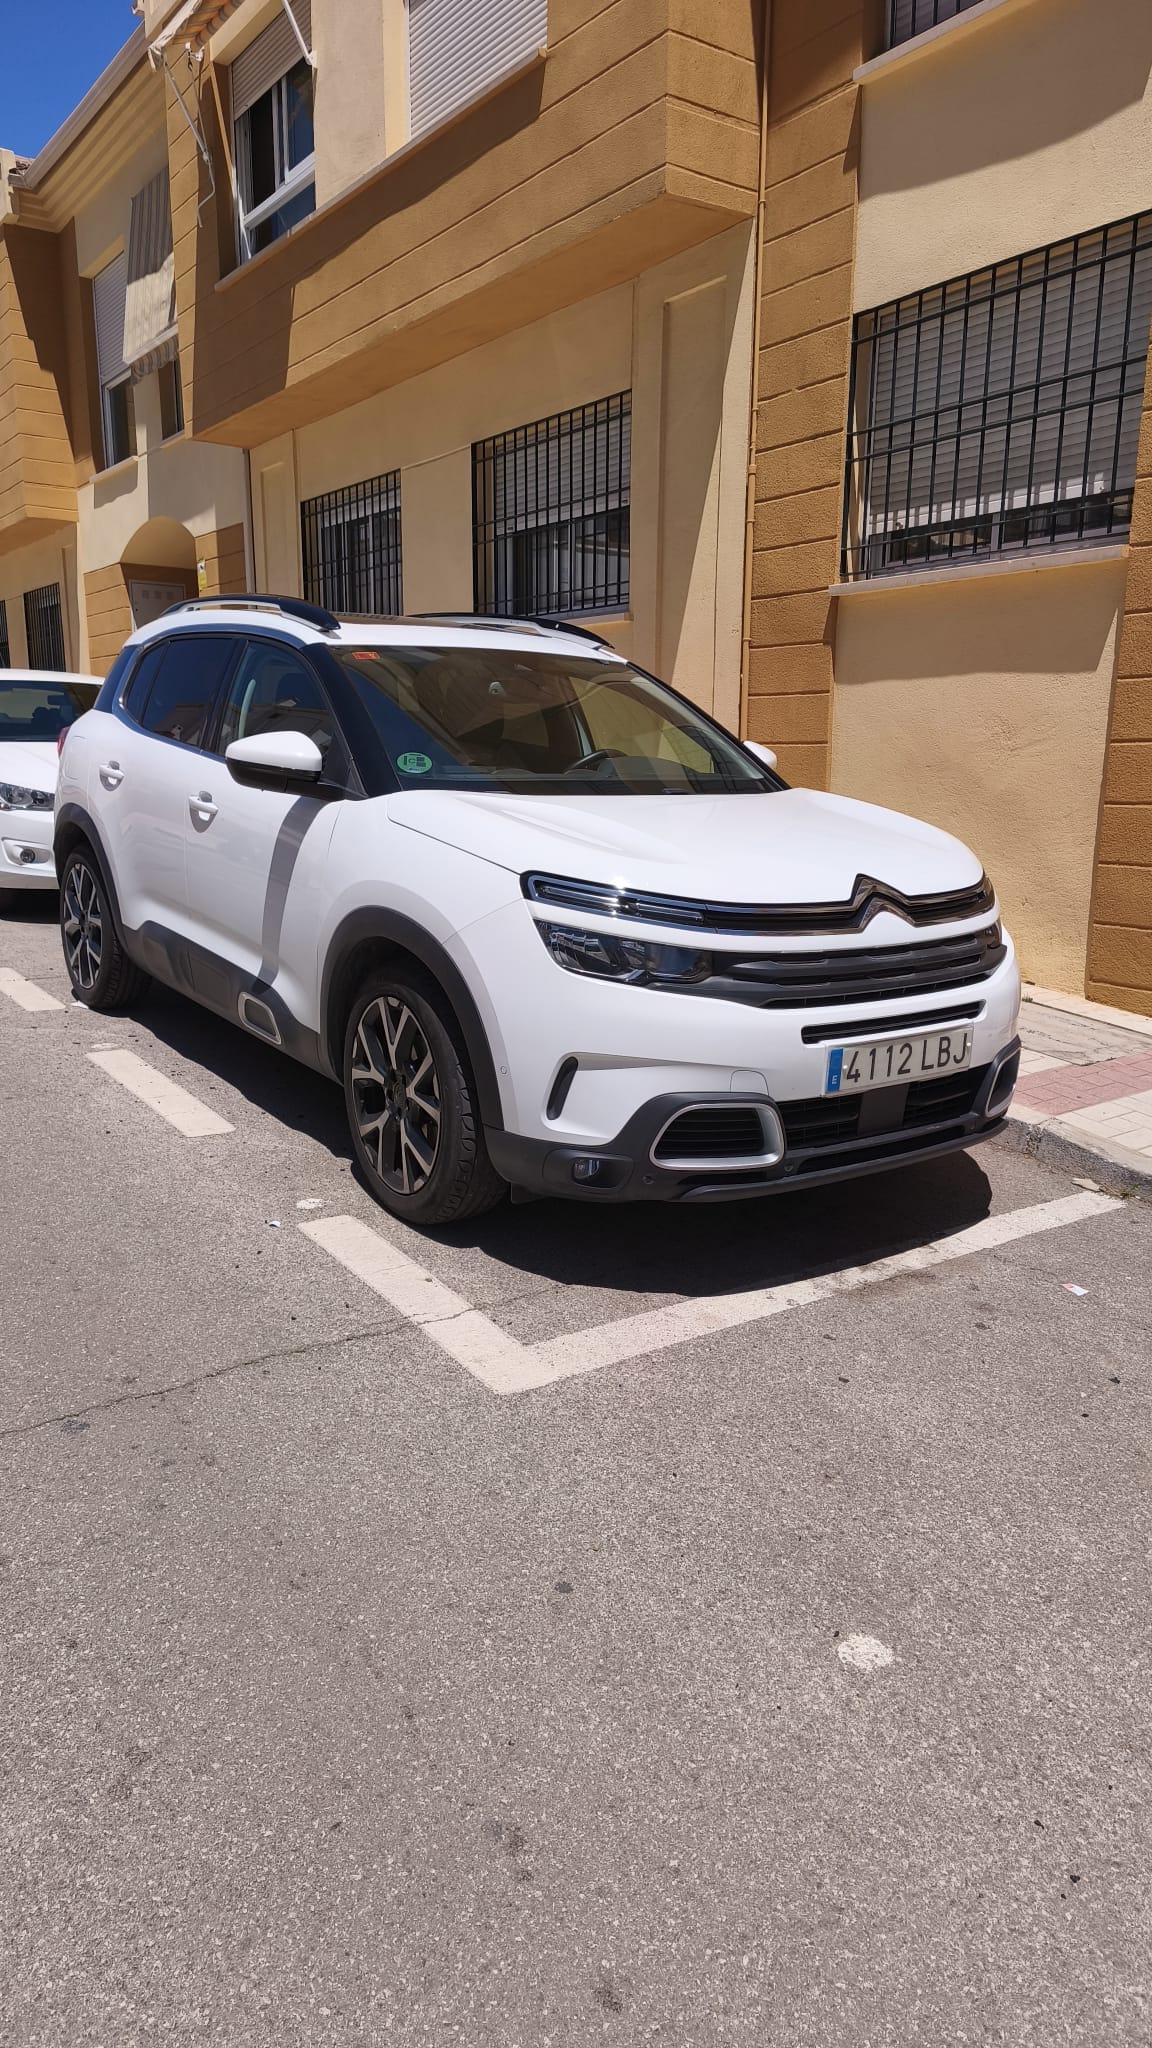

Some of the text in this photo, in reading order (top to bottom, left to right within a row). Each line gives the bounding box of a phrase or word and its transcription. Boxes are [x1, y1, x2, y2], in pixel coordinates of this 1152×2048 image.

[831, 1032, 968, 1085] E 4112 LBJ
